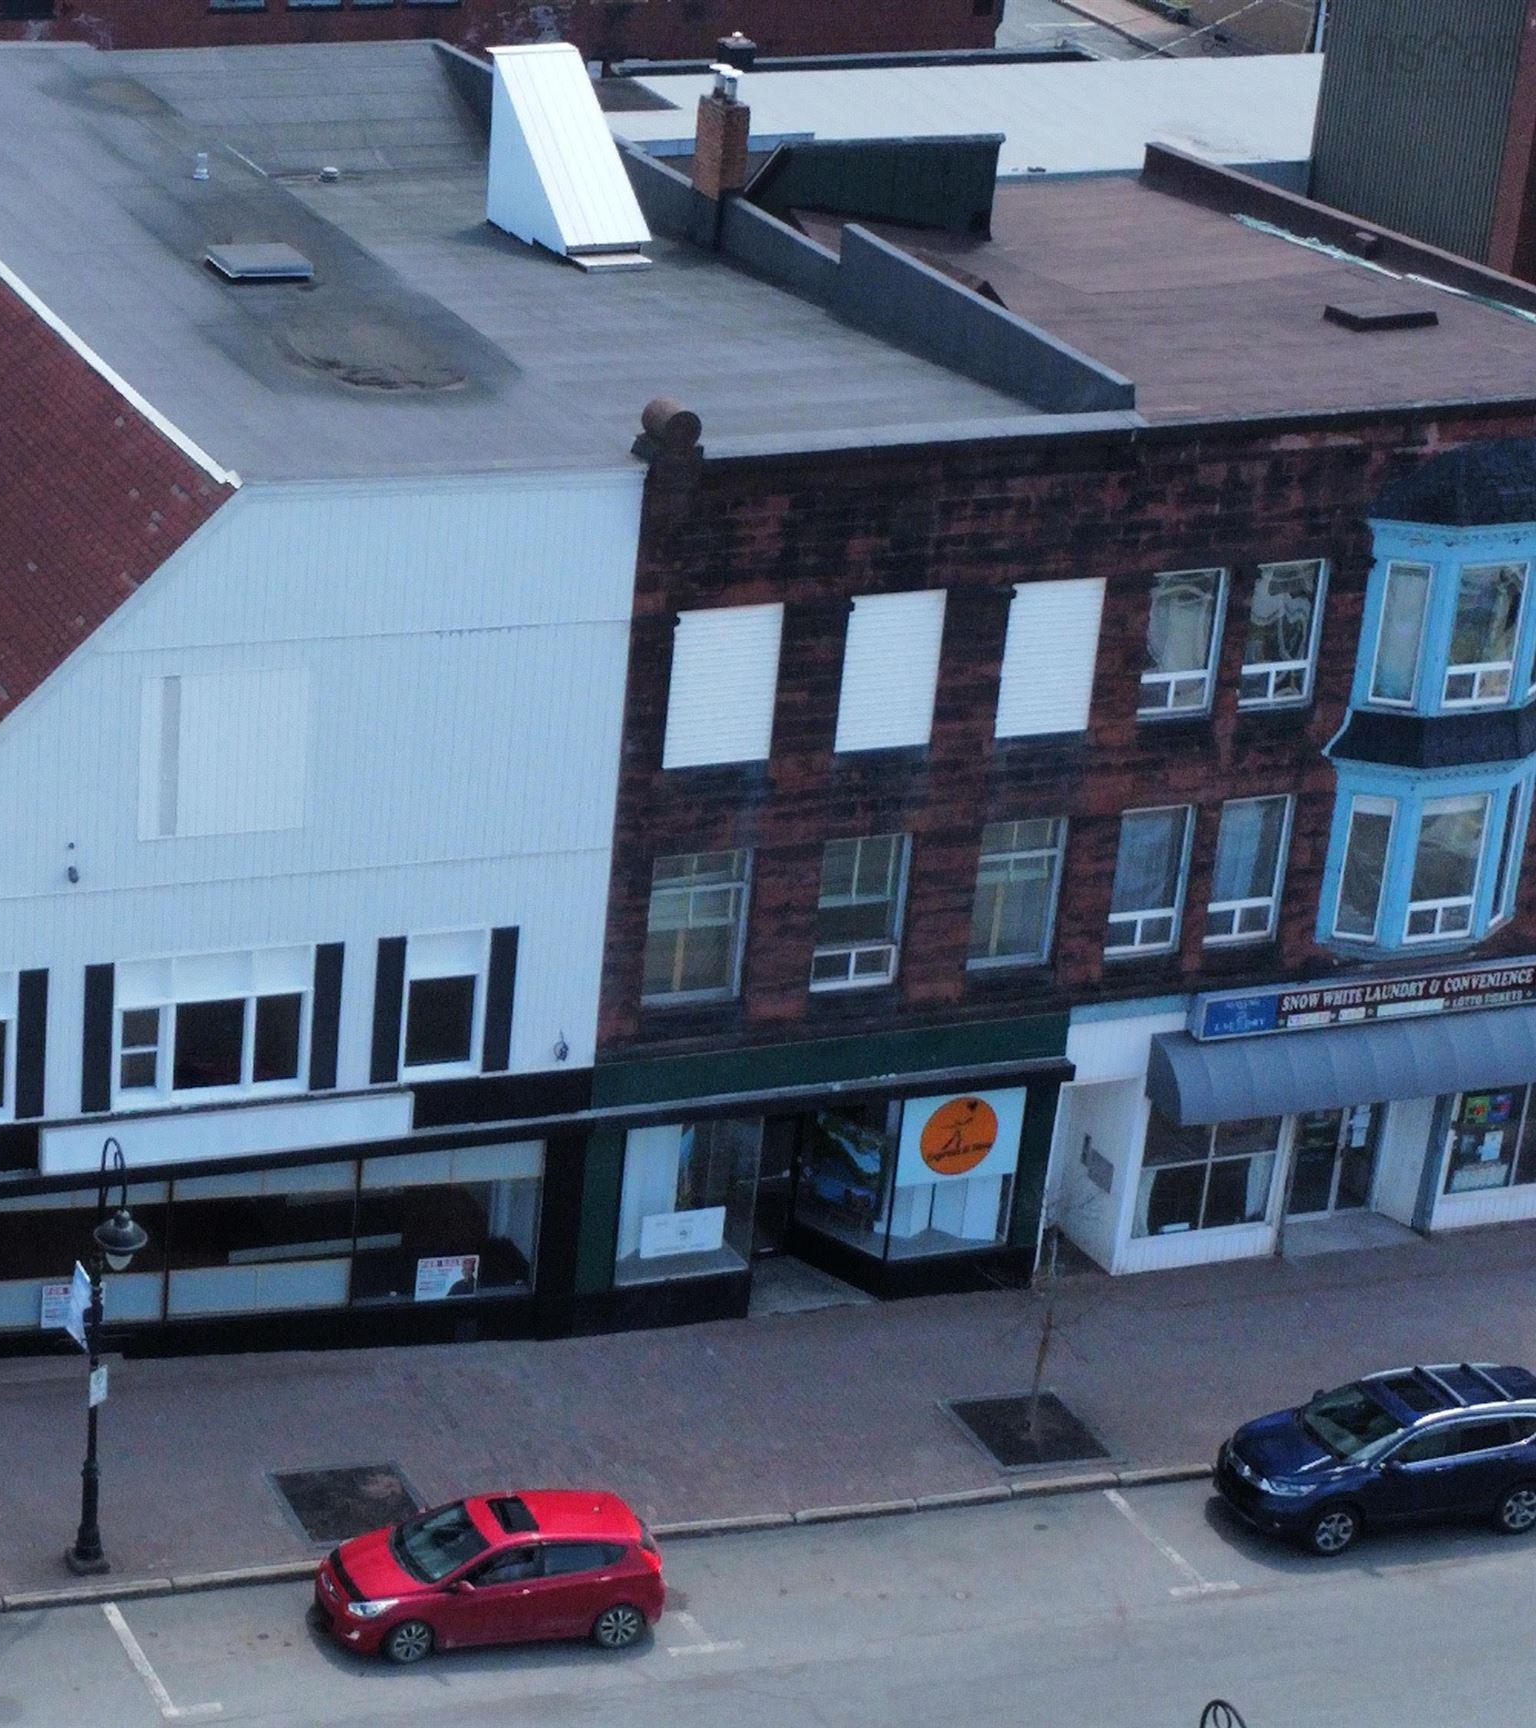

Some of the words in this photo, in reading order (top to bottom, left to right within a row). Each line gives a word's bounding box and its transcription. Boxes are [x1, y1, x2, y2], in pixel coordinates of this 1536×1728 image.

[1281, 992, 1321, 1011] SNOW
[1322, 988, 1363, 1006] WHITE
[1365, 981, 1426, 1001] LAUNDRY
[1444, 968, 1535, 993] CONVENIENCE
